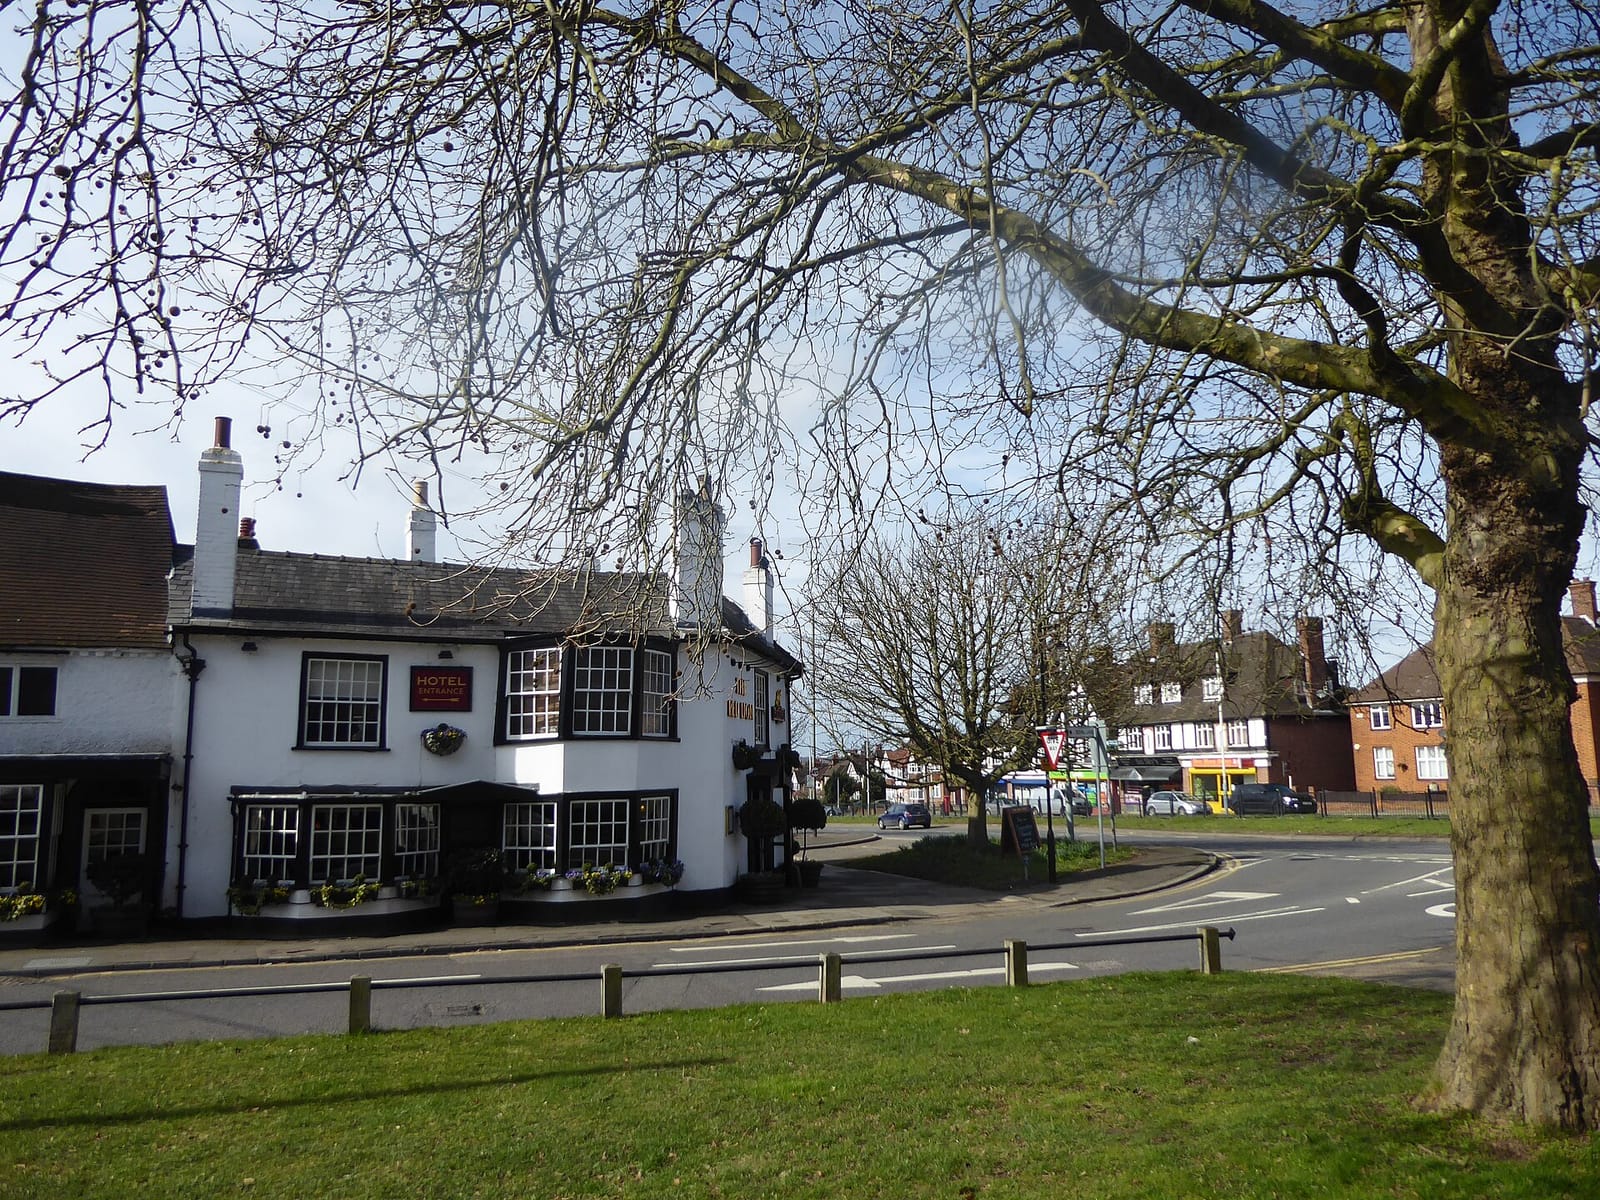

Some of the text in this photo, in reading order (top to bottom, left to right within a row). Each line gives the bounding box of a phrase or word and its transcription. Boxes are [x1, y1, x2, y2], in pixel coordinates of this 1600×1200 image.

[417, 676, 467, 686] HOTEL
[727, 700, 753, 721] RED LION
